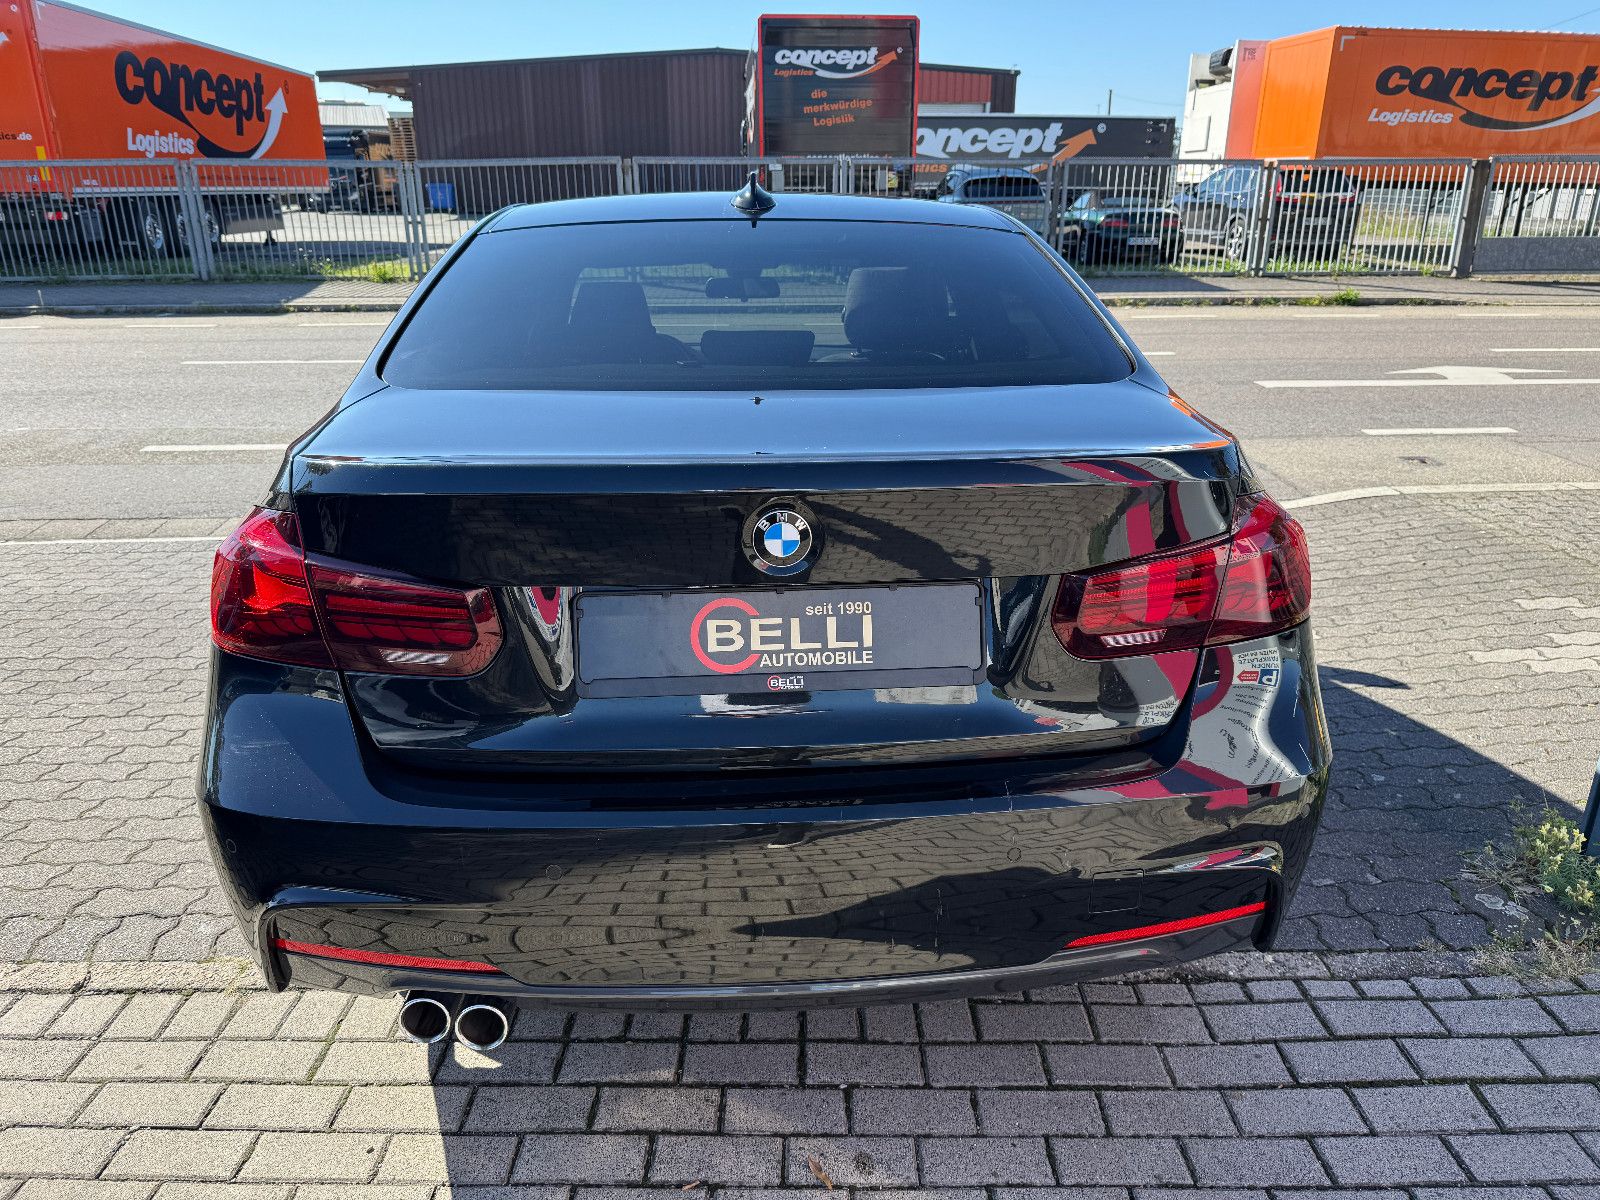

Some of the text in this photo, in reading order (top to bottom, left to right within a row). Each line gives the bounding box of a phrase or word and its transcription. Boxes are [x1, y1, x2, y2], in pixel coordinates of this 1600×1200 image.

[774, 47, 878, 70] concept
[774, 69, 814, 78] Logistics
[115, 51, 265, 136] concept
[811, 88, 828, 99] die
[1375, 65, 1599, 111] concept
[803, 99, 873, 114] merkwürdige
[813, 114, 855, 127] Logistik
[1367, 108, 1454, 126] Logistics
[127, 127, 195, 159] Logistics
[915, 122, 1063, 159] oncept
[757, 512, 808, 532] BMW
[805, 601, 872, 616] seit 1990
[706, 615, 873, 653] BELLI
[759, 650, 873, 667] AUTOMOBILE
[770, 678, 804, 687] BELLI
